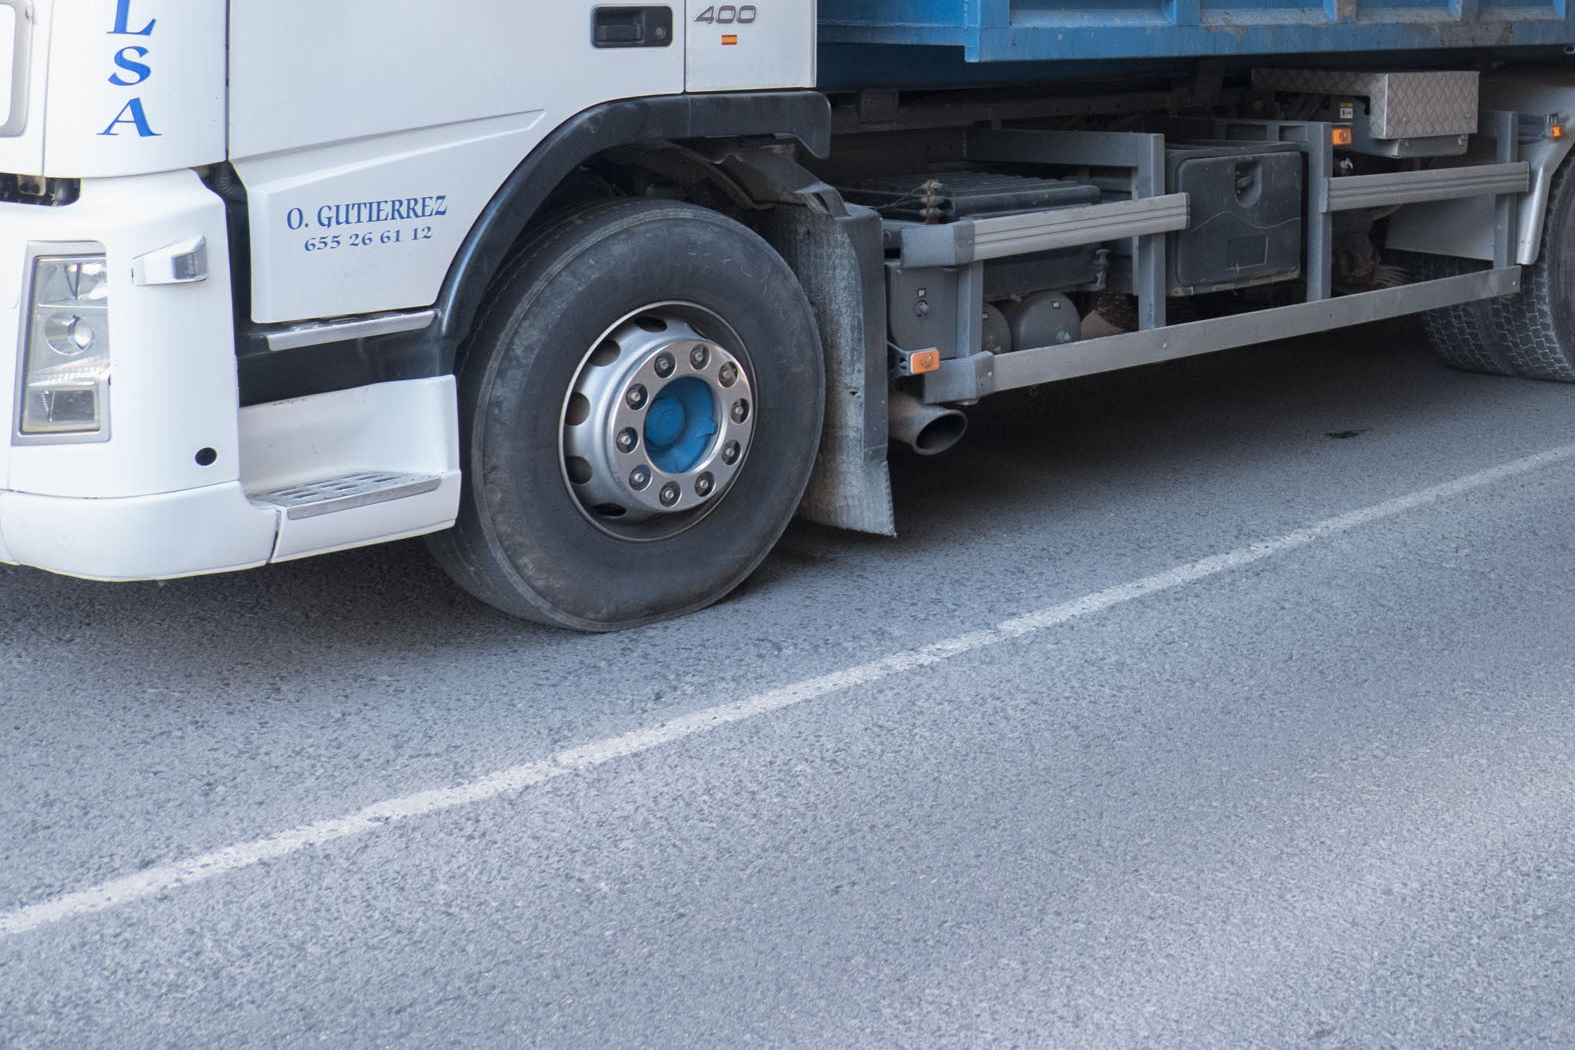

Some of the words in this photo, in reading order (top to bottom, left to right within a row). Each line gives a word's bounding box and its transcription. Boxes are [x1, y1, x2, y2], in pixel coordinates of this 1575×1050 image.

[694, 5, 757, 25] 400
[286, 207, 309, 230] O.
[317, 195, 448, 229] GUTIERREZ
[304, 234, 342, 252] 655
[349, 232, 373, 247] 26
[380, 229, 401, 244] 61
[411, 226, 433, 241] 12
